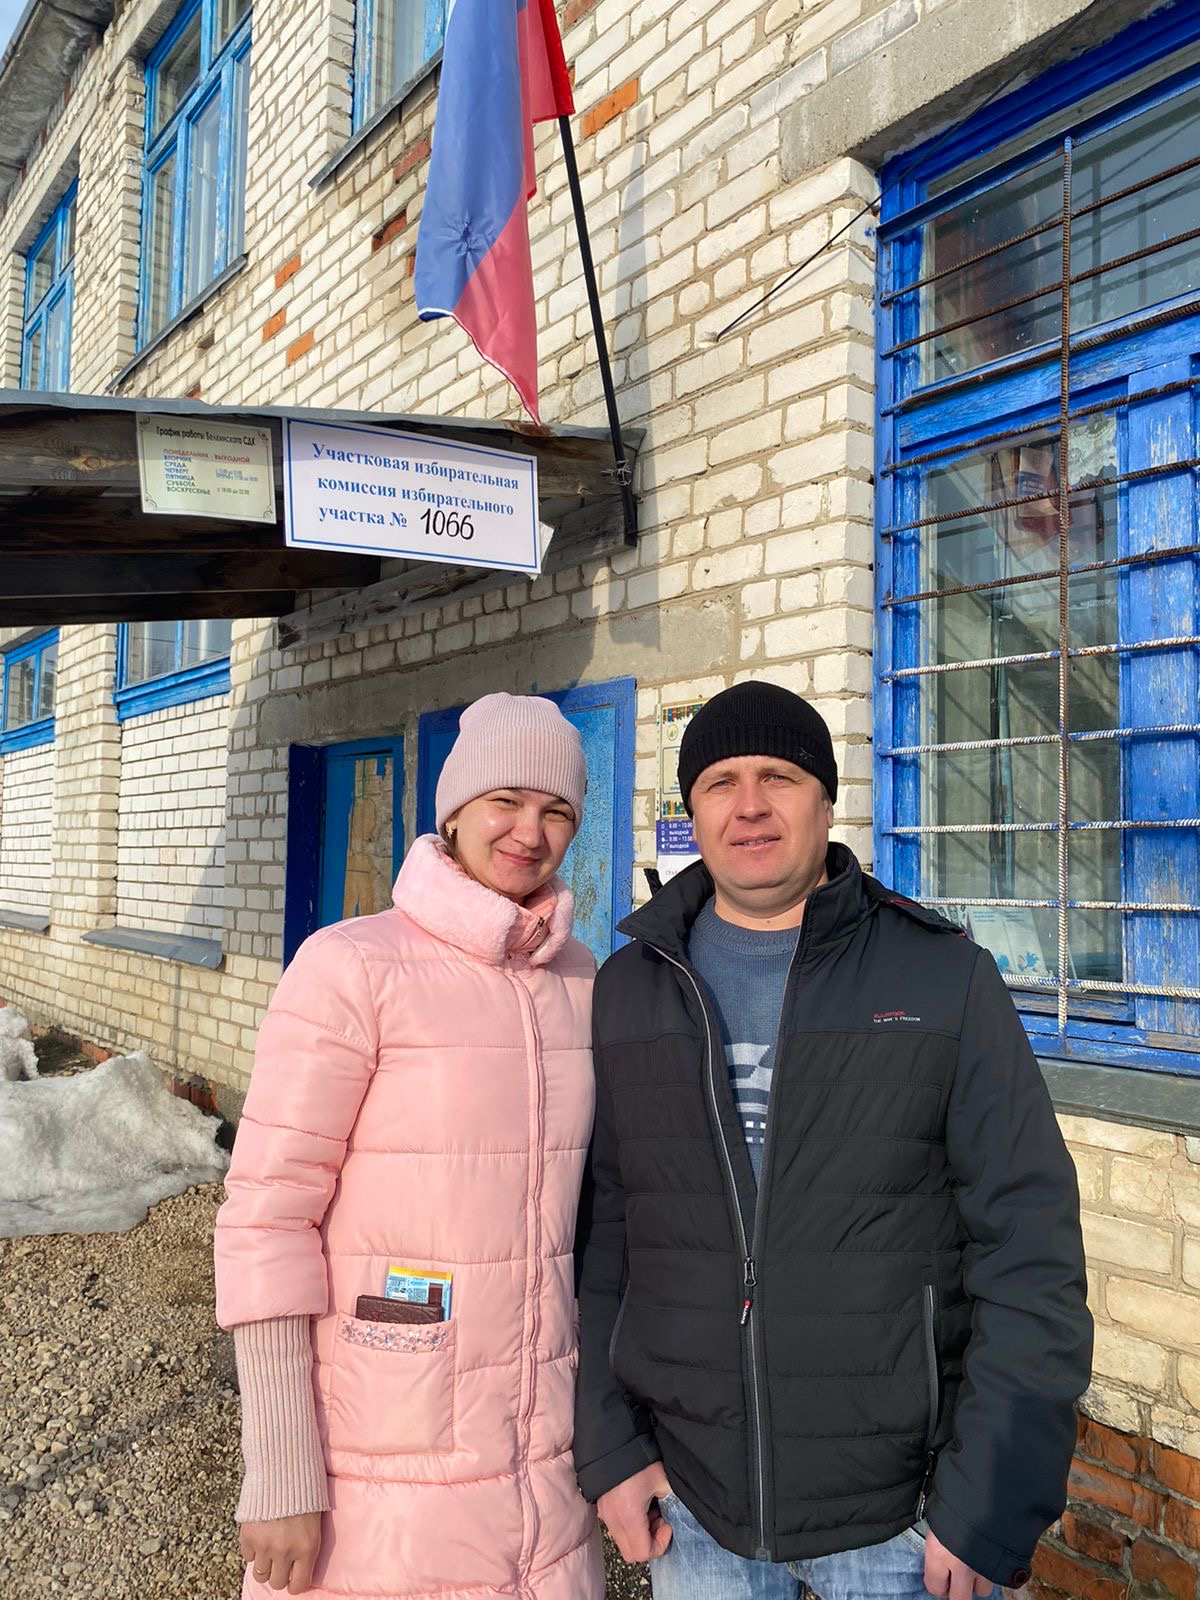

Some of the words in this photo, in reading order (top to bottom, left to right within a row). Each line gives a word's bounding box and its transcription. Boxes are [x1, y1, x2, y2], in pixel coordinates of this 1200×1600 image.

[156, 426, 180, 438] График
[181, 429, 204, 439] работы
[243, 437, 256, 446] СДК
[163, 448, 209, 458] ПОНЕДЕЛЬНИК
[214, 453, 250, 463] ВЫХОДНОЙ
[311, 442, 410, 472] Участковая
[414, 461, 519, 490] избирательная
[165, 473, 195, 481] ПЯТНИЦА
[167, 486, 211, 495] ВОСКРЕСЕНЬЕ
[317, 476, 397, 498] комиссия
[401, 487, 515, 516] избирательного
[319, 506, 385, 526] участка
[389, 511, 408, 528] №
[420, 508, 474, 540] 1066
